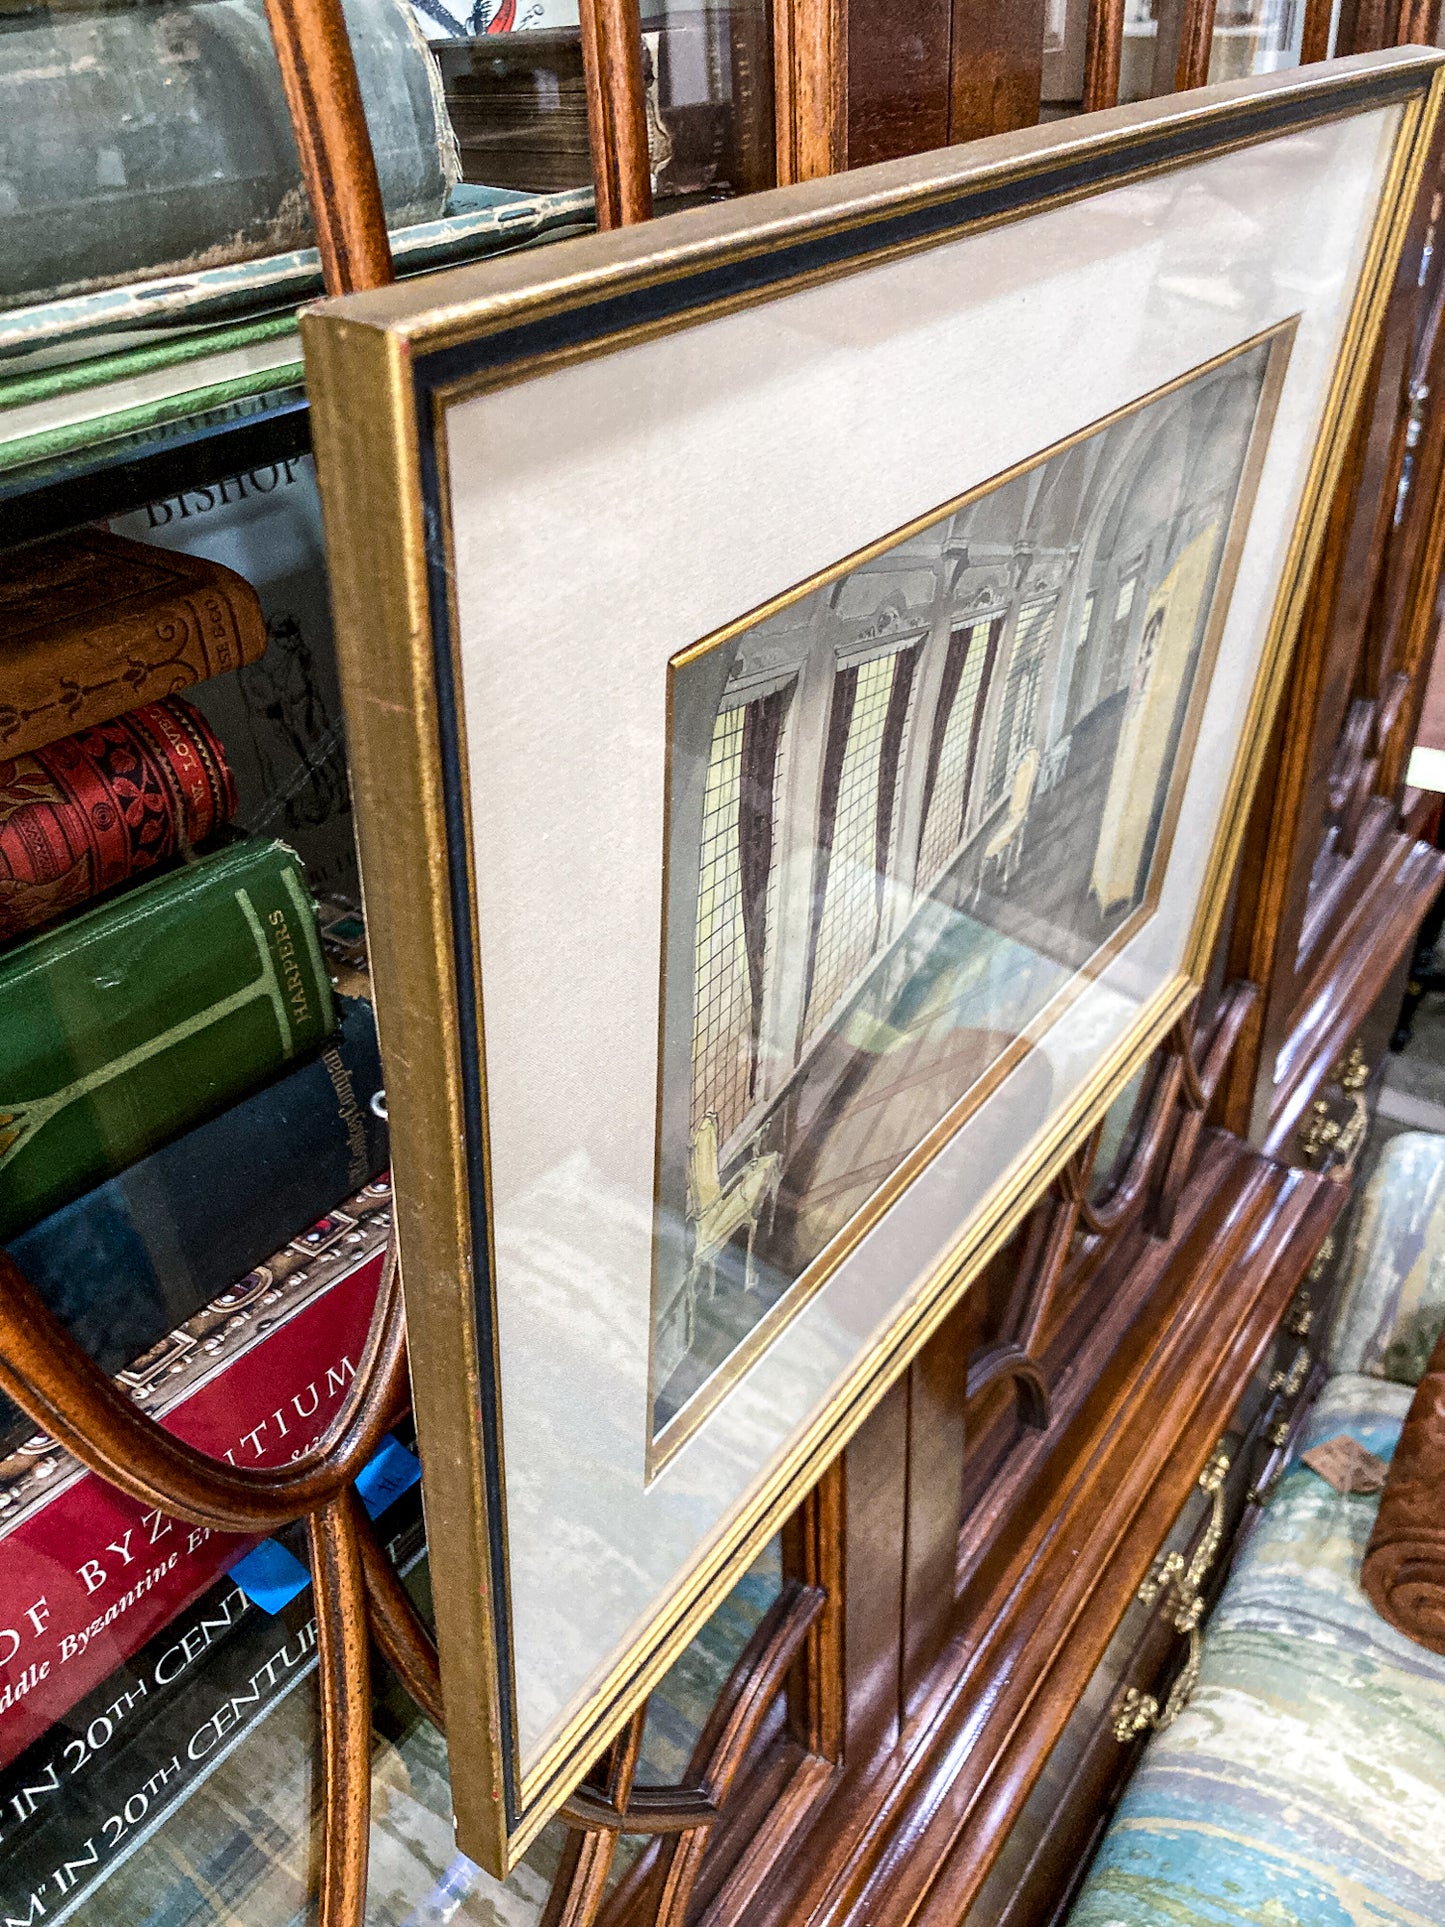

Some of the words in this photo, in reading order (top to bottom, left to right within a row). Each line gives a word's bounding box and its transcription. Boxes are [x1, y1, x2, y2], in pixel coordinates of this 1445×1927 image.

[142, 703, 199, 772] LOVEL
[269, 910, 312, 1025] HARPERS
[322, 1045, 358, 1118] Compan
[58, 1552, 178, 1665] Byzantine
[9, 1763, 60, 1823] IN
[63, 1678, 148, 1774] 20TH
[52, 1838, 99, 1896] IN
[102, 1755, 182, 1848] 20TH
